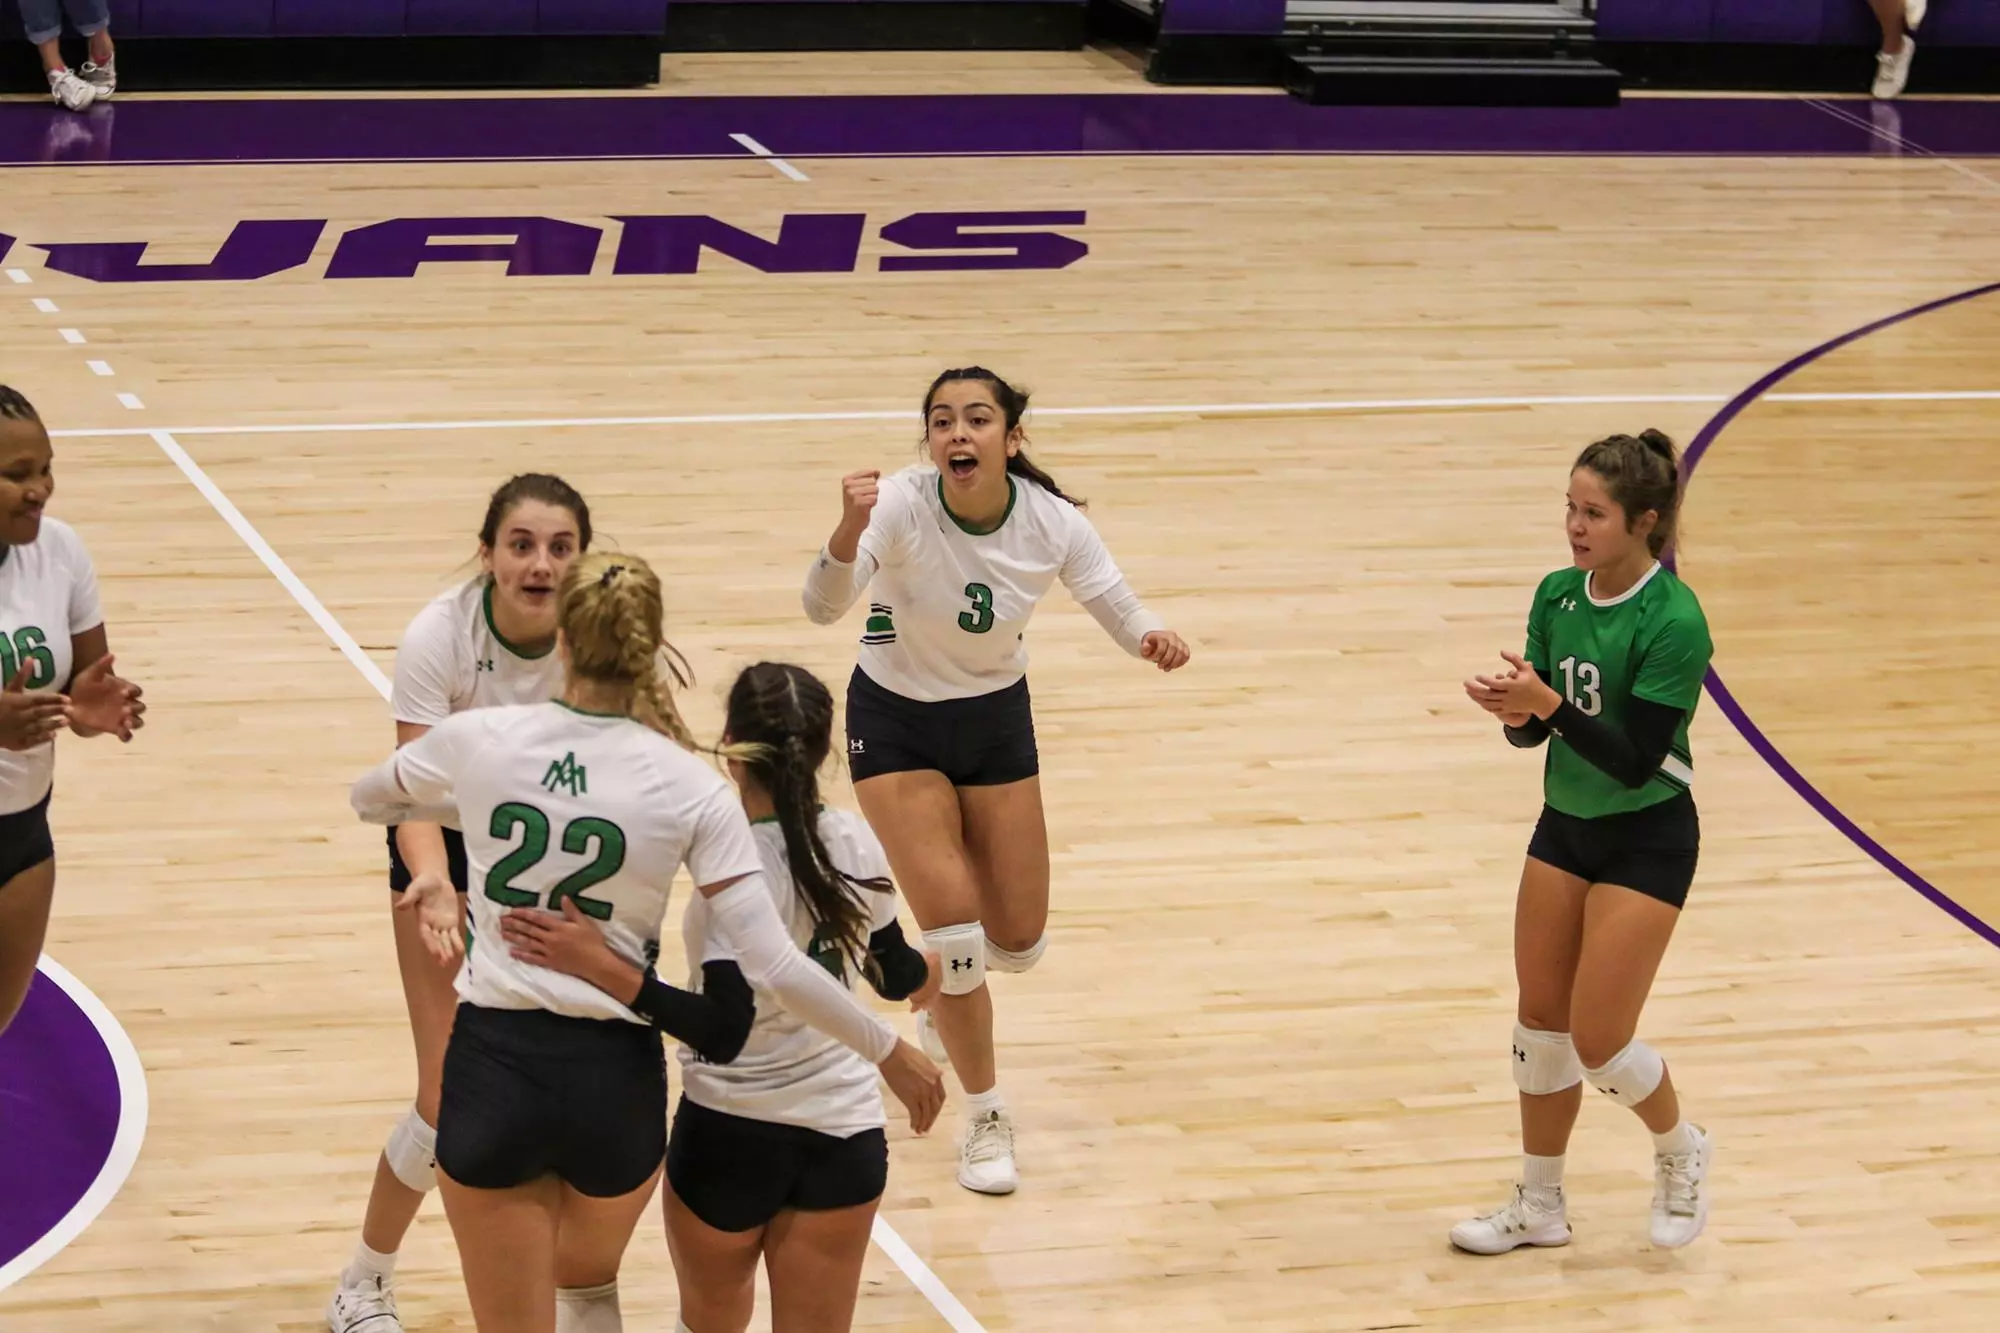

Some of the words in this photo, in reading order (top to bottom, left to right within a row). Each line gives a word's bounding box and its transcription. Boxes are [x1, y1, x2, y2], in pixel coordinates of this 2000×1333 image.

[0, 210, 1089, 283] JANS
[958, 582, 995, 634] 3
[0, 625, 56, 690] 16
[1558, 655, 1603, 717] 13
[484, 801, 626, 922] 22
